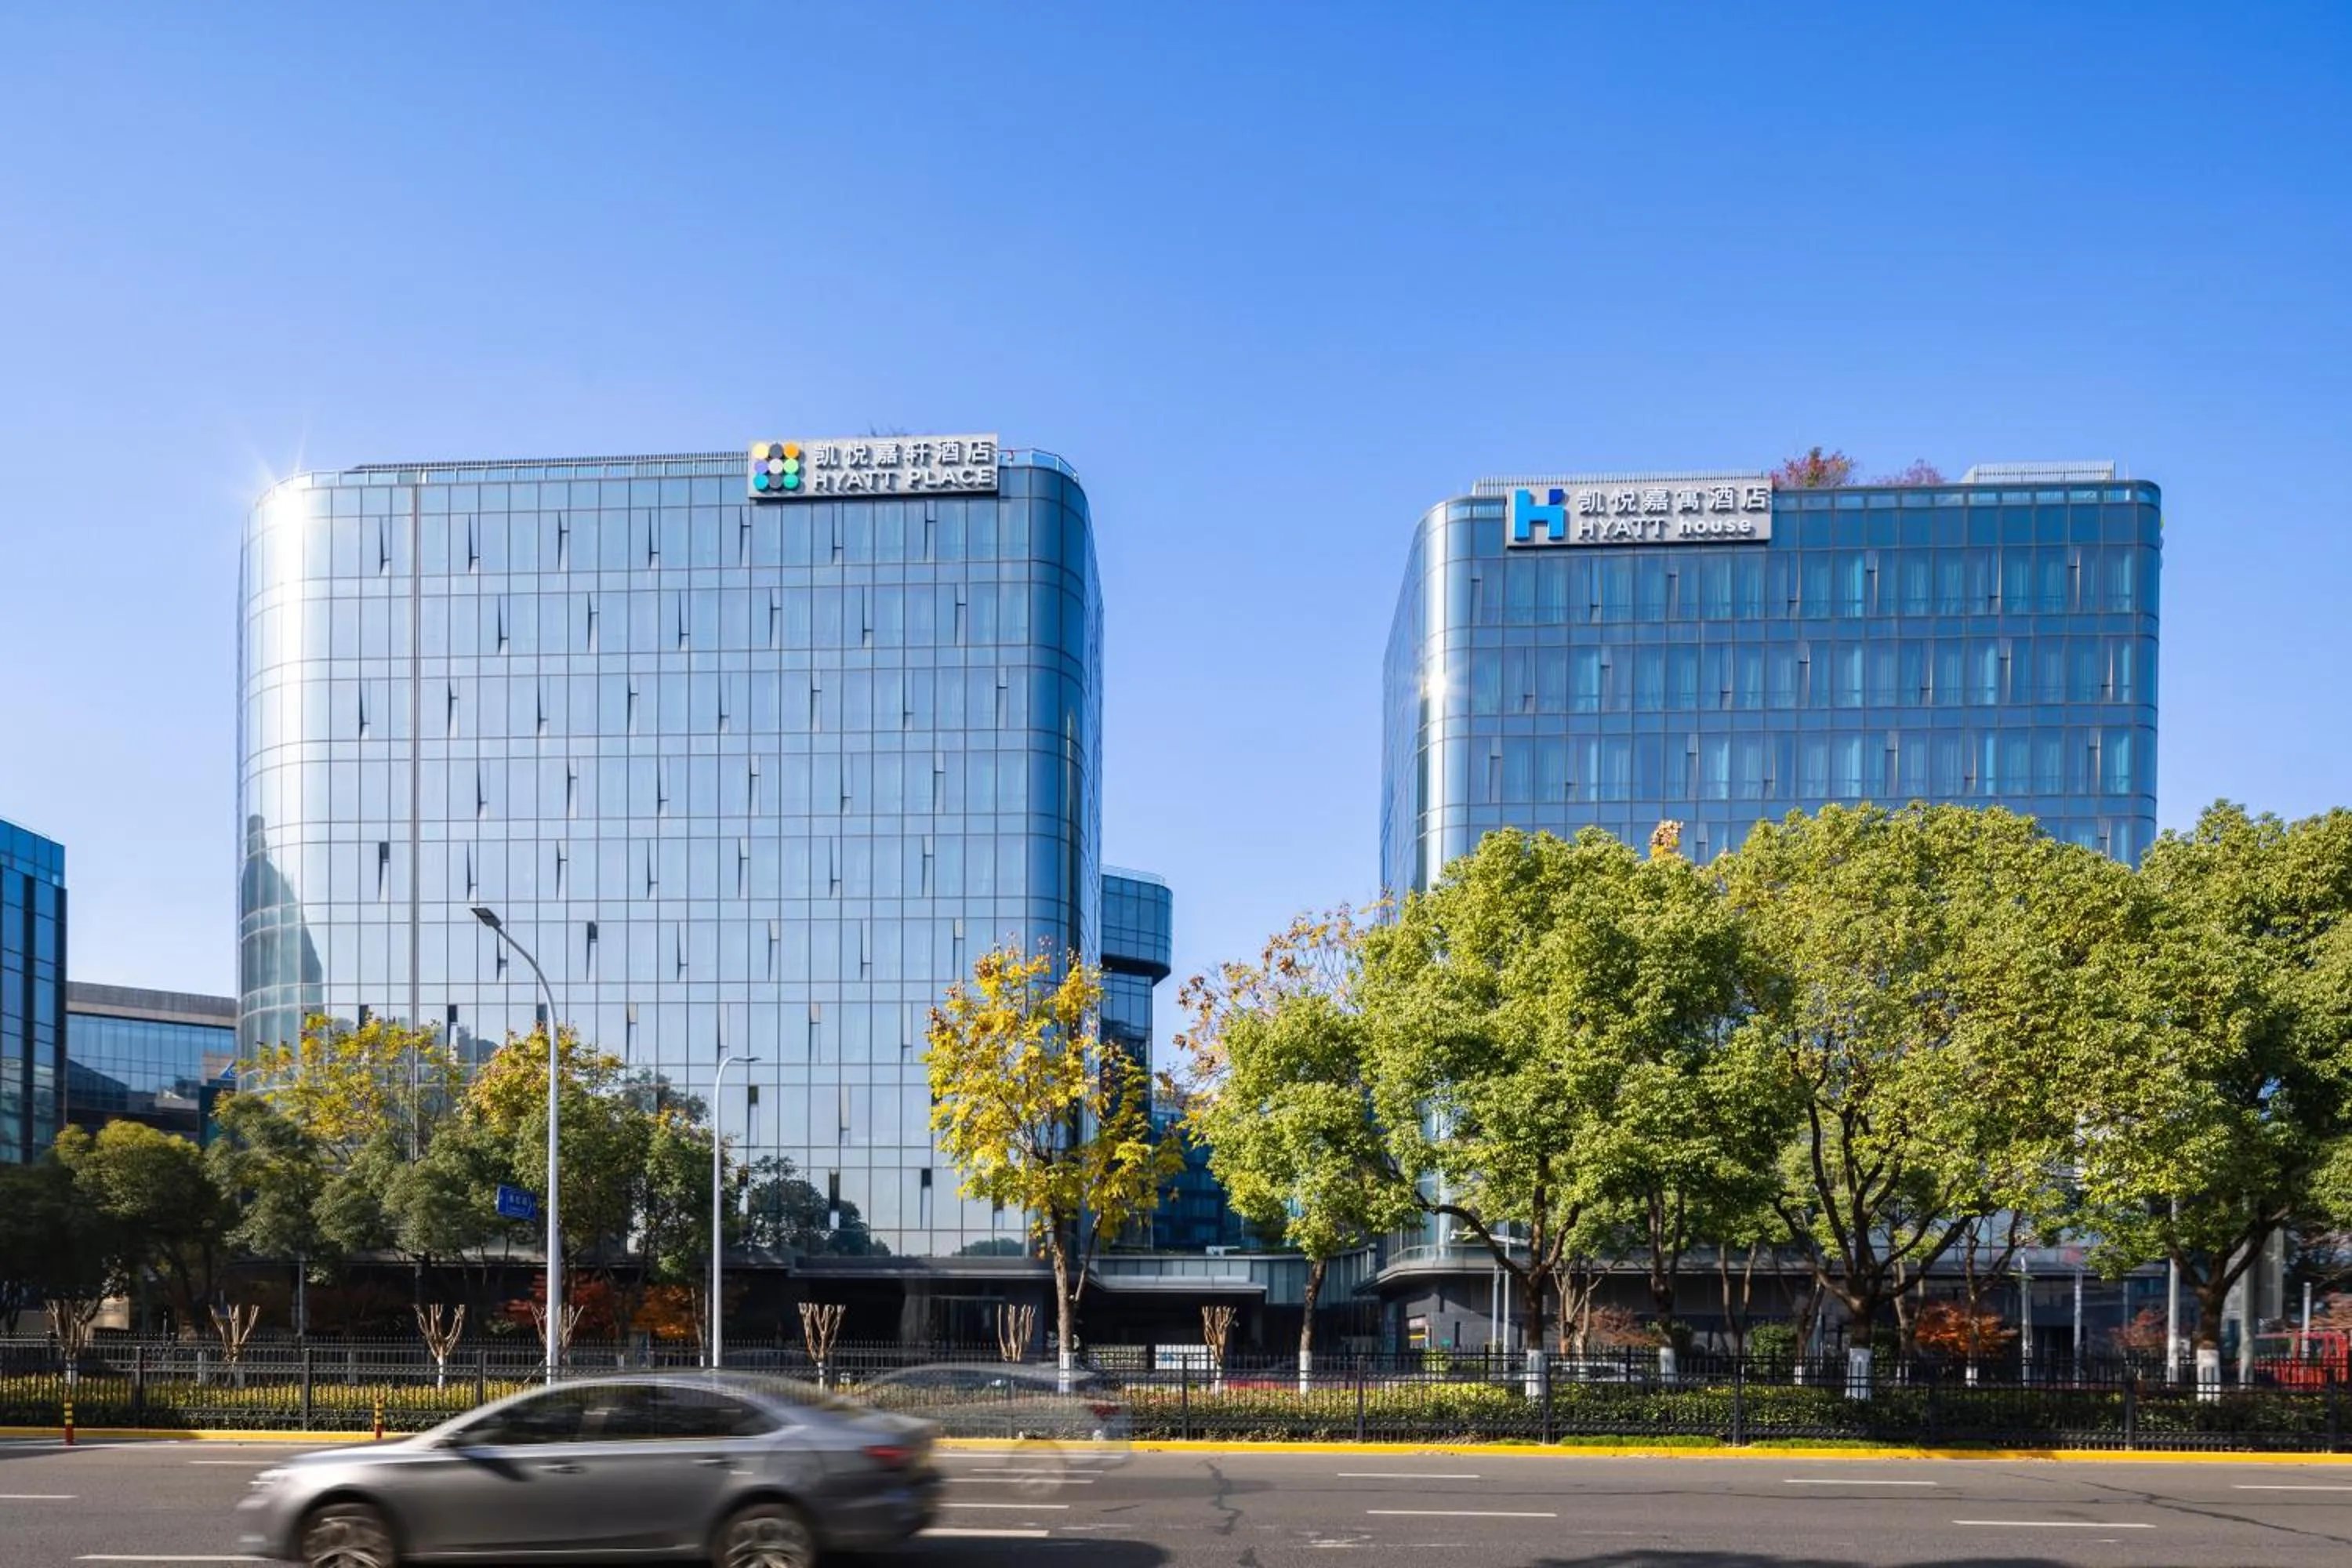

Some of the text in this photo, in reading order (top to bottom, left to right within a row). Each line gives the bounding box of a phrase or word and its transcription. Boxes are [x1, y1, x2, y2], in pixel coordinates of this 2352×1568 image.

[814, 439, 991, 466] 凯悦嘉轩酒店
[814, 469, 993, 492] HYATT PLACE
[1578, 486, 1767, 512] 凯悦嘉寓酒店
[1578, 517, 1751, 539] HYATT house
